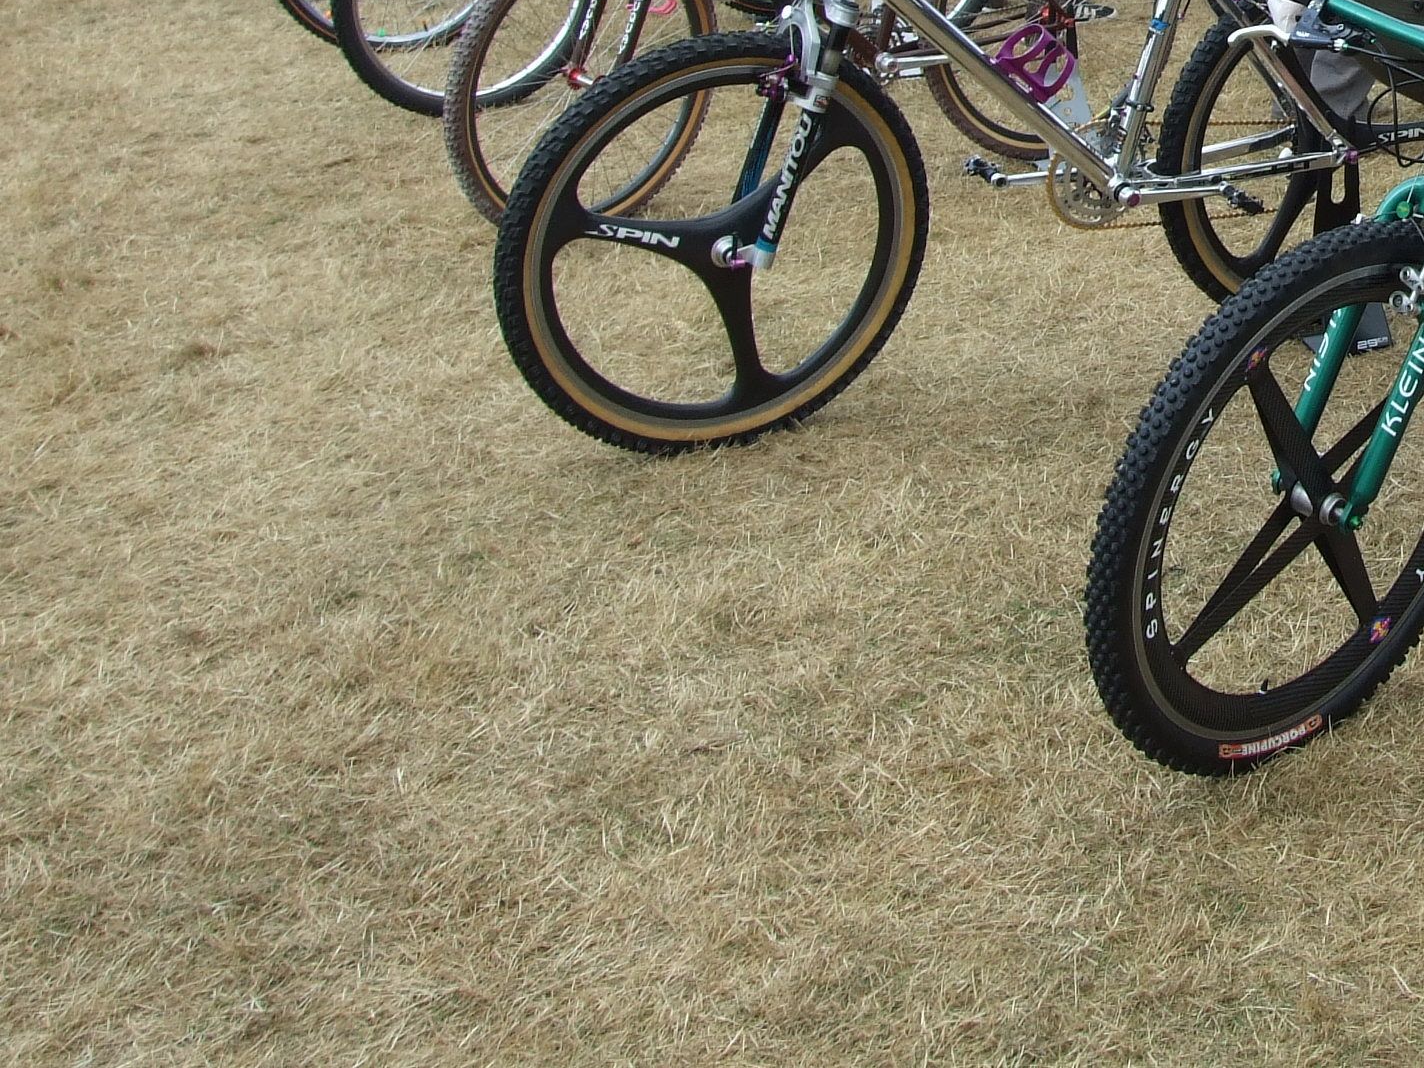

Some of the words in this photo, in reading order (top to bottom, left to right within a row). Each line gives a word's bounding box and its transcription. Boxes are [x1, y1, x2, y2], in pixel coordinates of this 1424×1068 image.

[763, 112, 812, 239] MANITOU
[585, 224, 680, 249] SPIN
[1146, 408, 1214, 638] SPINERGY
[1241, 723, 1306, 755] PORCUPINE
